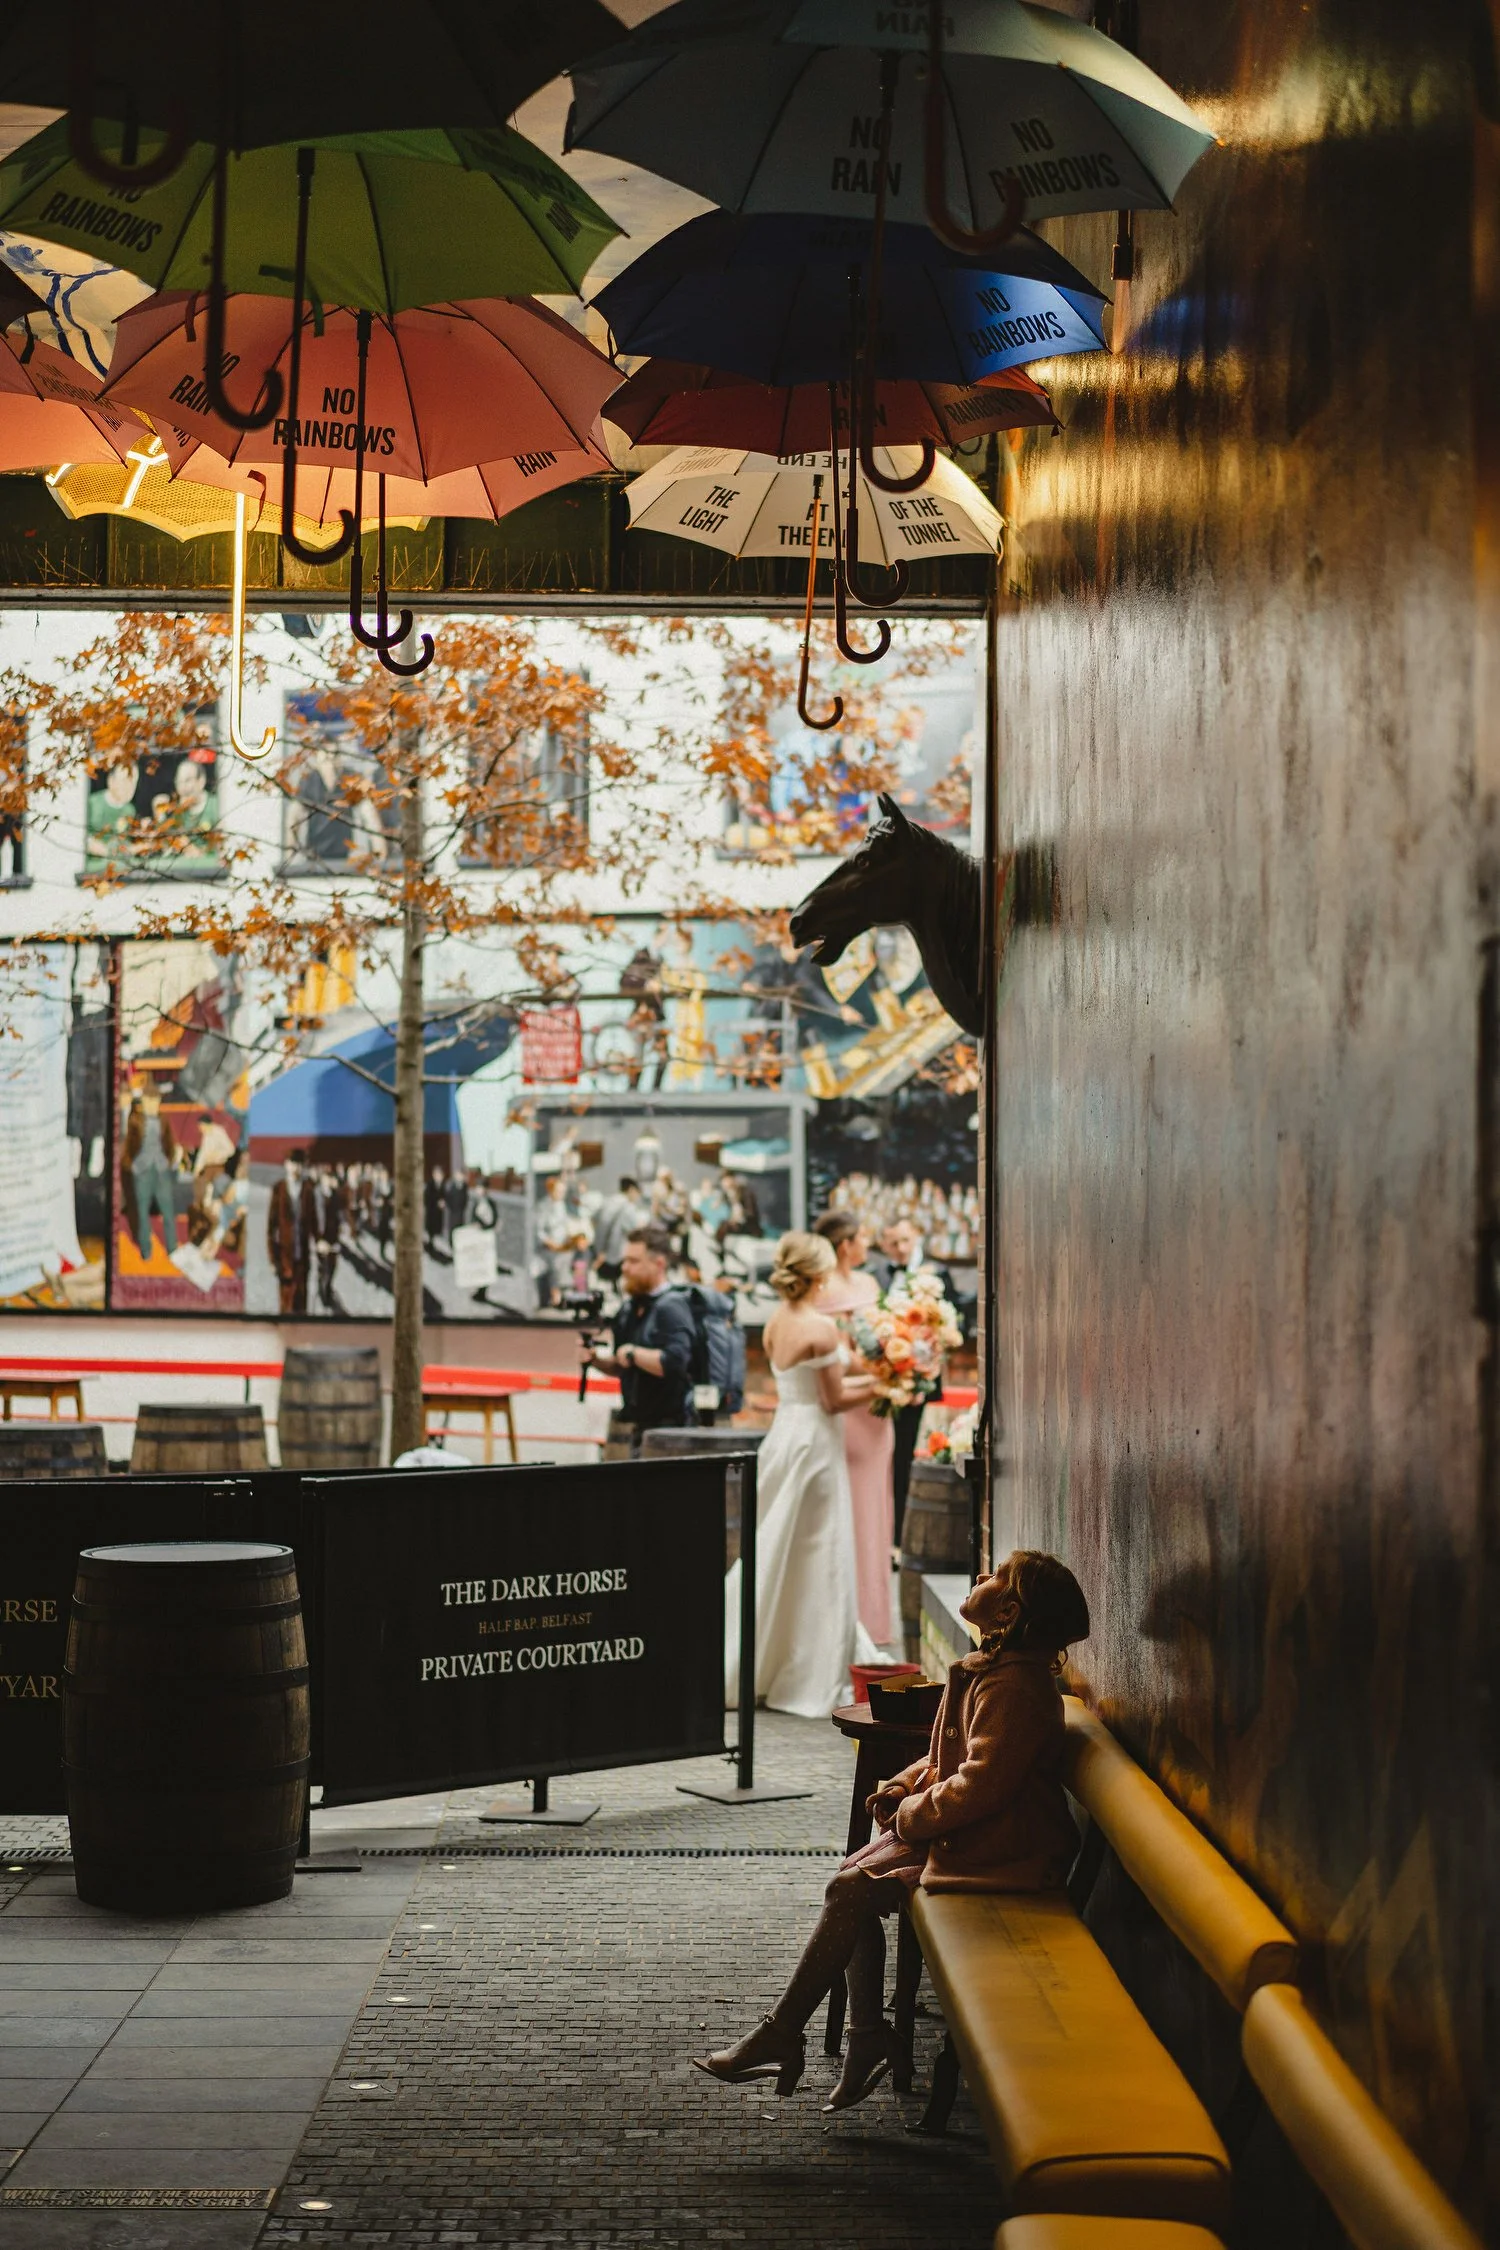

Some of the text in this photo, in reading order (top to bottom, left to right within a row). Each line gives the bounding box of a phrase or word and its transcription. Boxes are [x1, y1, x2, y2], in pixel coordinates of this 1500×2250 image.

[849, 116, 892, 149] NO
[1010, 118, 1055, 152] NO
[831, 157, 902, 196] RAIN
[39, 191, 163, 252] RAINBOWS
[975, 287, 1011, 316] NO
[967, 311, 1066, 360] RAINBOWS
[321, 387, 357, 415] NO
[273, 418, 396, 456] RAINBOWS
[705, 486, 740, 509] THE
[888, 497, 943, 520] OF THE
[679, 506, 729, 535] LIGHT
[805, 503, 829, 522] AT
[778, 525, 813, 546] THE
[898, 522, 960, 546] TUNNEL
[440, 1568, 628, 1606] THE DARK HORSE
[0, 1598, 58, 1623] RSE
[478, 1619, 512, 1635] HALF
[541, 1611, 594, 1629] BELFAST
[420, 1636, 645, 1681] PRIVATE COURTYARD
